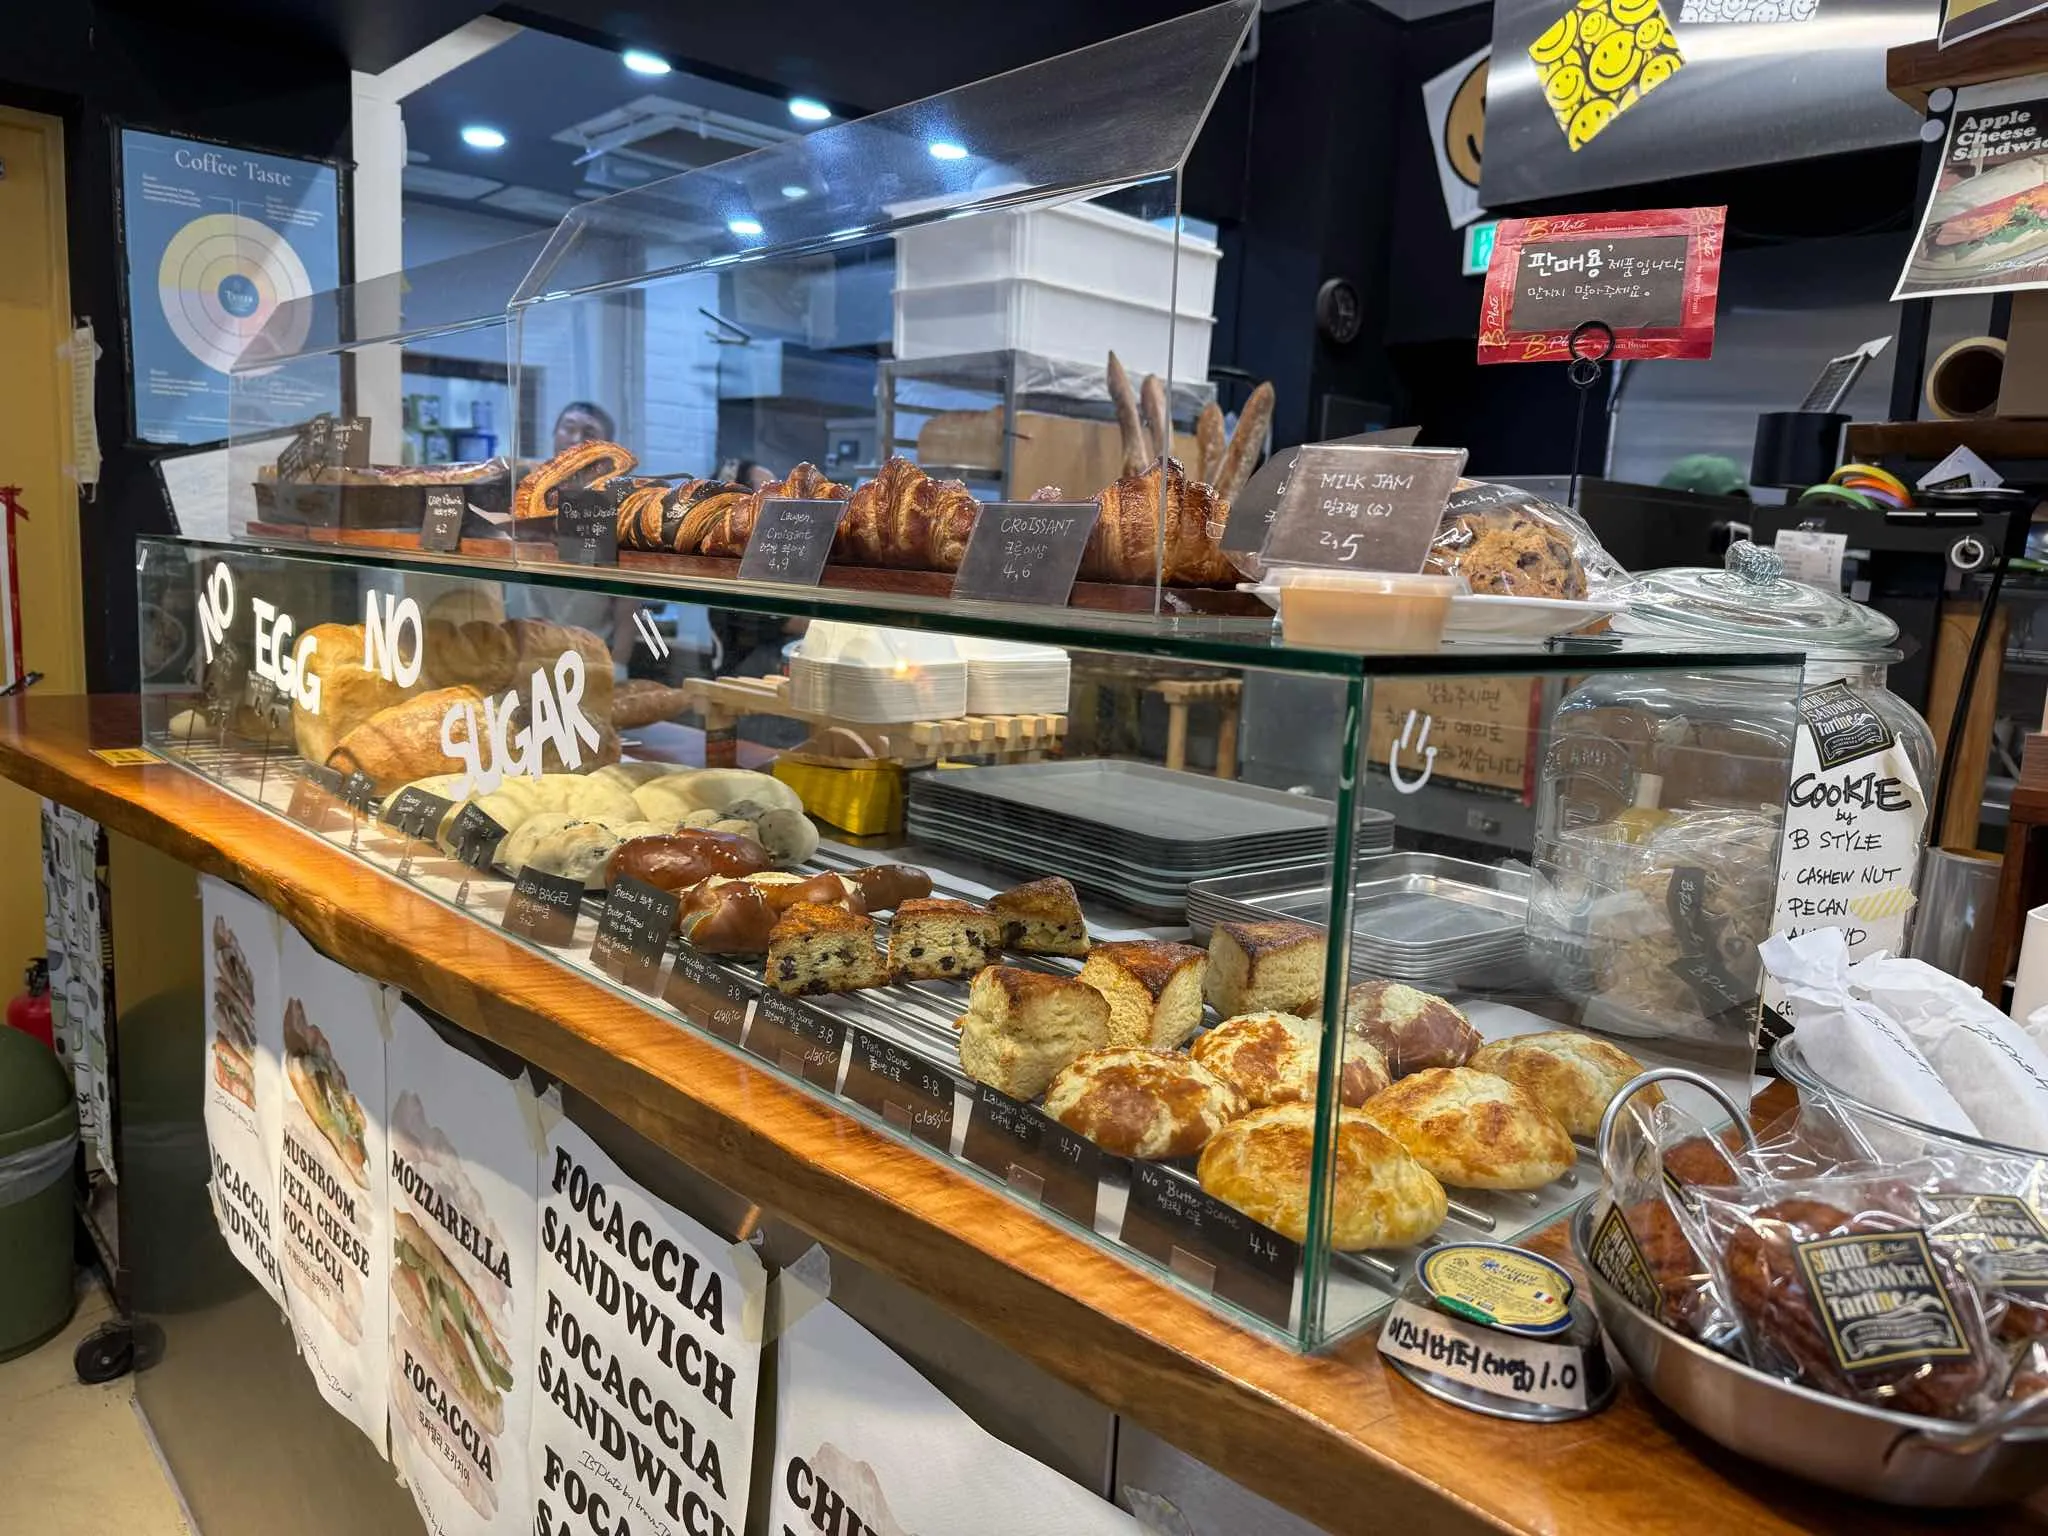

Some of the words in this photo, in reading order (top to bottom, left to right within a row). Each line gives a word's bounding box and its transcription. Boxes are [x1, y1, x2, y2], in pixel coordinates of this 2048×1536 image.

[1957, 126, 2037, 146] Cheese
[1960, 110, 2032, 132] Apple
[174, 149, 238, 178] Coffee
[243, 160, 293, 187] Taste
[1320, 473, 1367, 491] MILK
[1371, 473, 1415, 491] JAM
[1323, 497, 1360, 518] 밀크잼
[1000, 516, 1075, 537] CROISSANT
[198, 561, 236, 665] NO
[252, 598, 322, 716] EGG
[363, 588, 423, 689] NO
[440, 649, 601, 801] SUGAR
[1807, 699, 1863, 722] SANDWICH
[1815, 714, 1854, 737] Tartine
[1835, 808, 1858, 826] by
[1788, 829, 1810, 851] B
[1820, 829, 1883, 852] STYLE
[1796, 866, 1855, 886] CASHEW
[1860, 865, 1902, 884] NUT
[539, 887, 572, 906] BAGEL
[1788, 897, 1849, 918] PECAN
[817, 1025, 834, 1044] 3.8
[860, 1035, 882, 1057] Plain
[886, 1048, 912, 1070] Scone
[922, 1074, 940, 1097] 3.8
[983, 1089, 1017, 1116] Laugen
[1020, 1107, 1047, 1132] Scone
[1060, 1136, 1082, 1163] 4.7
[282, 1127, 356, 1225] MUSHROOM
[1142, 1169, 1158, 1187] No
[1165, 1179, 1201, 1208] Butter
[1204, 1200, 1240, 1230] Scone
[282, 1164, 314, 1217] FETA
[316, 1202, 370, 1279] CHEESE
[391, 1150, 513, 1289] MOZZARELLA
[282, 1200, 345, 1294] FOCACCIA
[551, 1145, 726, 1337] FOCACCIA
[1249, 1231, 1279, 1262] 4.4
[1809, 1243, 1868, 1274] SALAD
[1818, 1262, 1933, 1296] SANDWICH
[541, 1206, 737, 1420] SANDWICH
[1826, 1290, 1904, 1321] Tartine
[1540, 1361, 1577, 1390] 1.0
[545, 1288, 728, 1501] FOCACCIA
[403, 1348, 494, 1482] FOCACCIA
[622, 1484, 634, 1511] by
